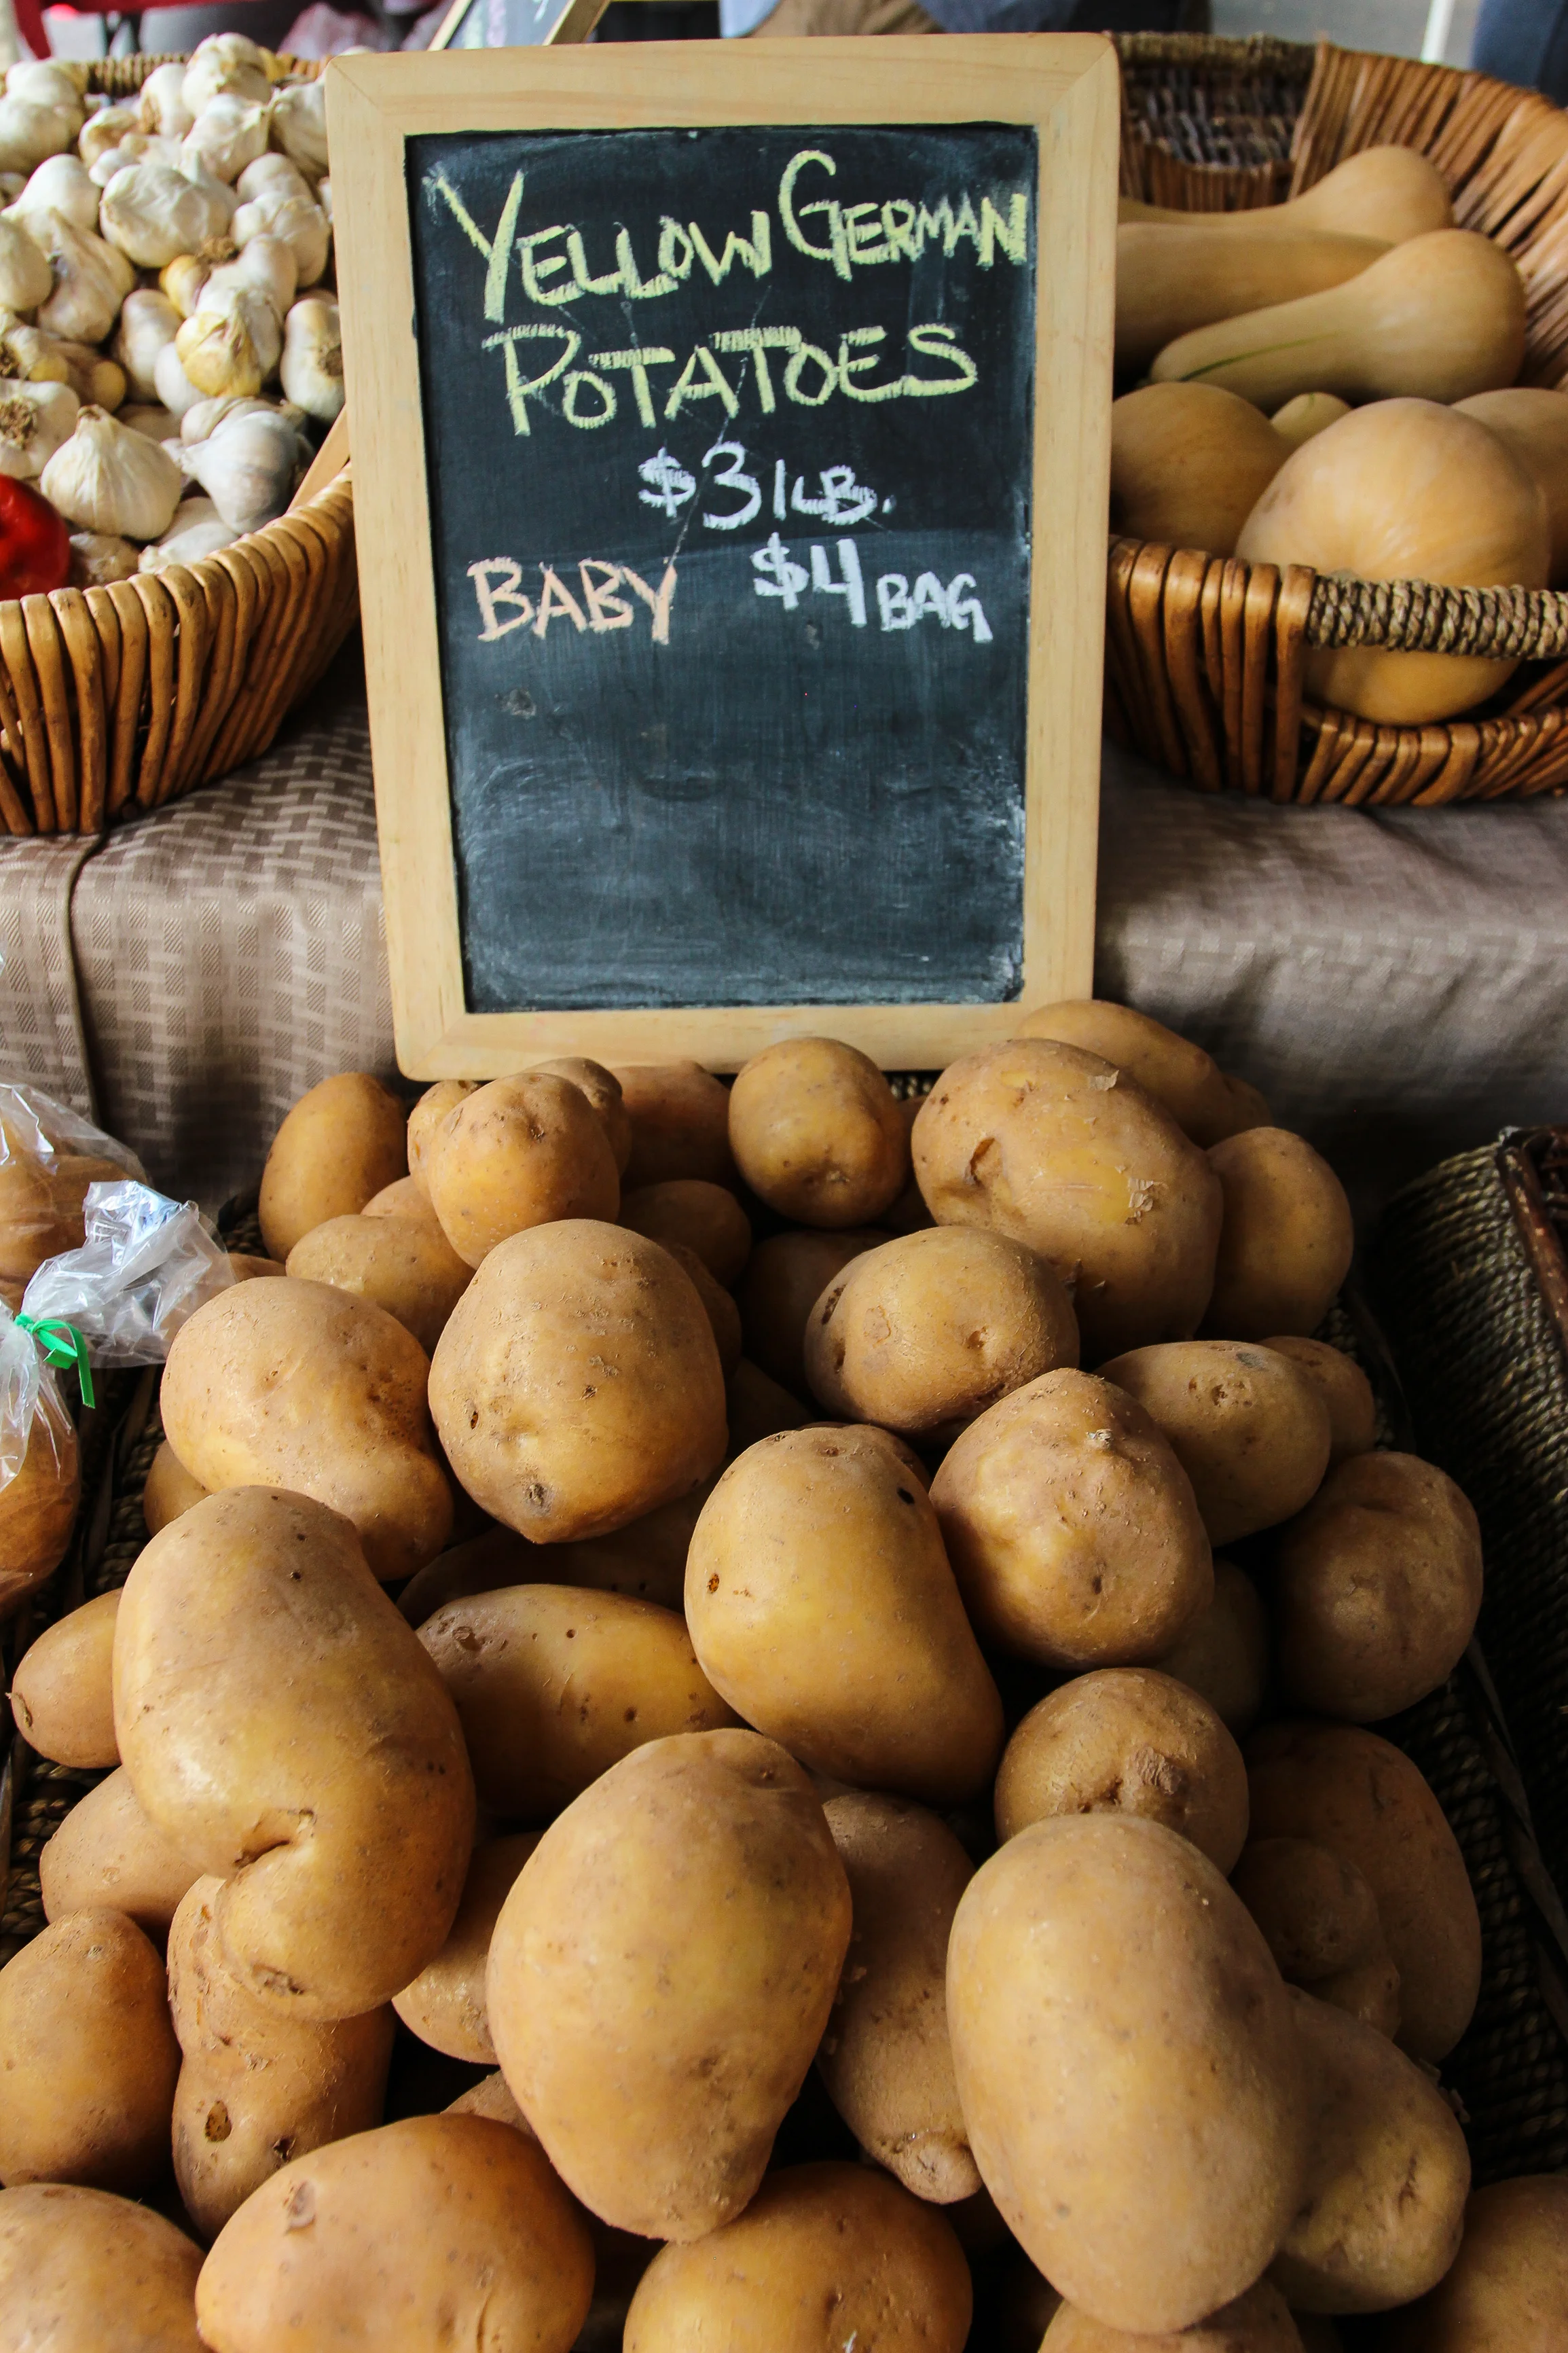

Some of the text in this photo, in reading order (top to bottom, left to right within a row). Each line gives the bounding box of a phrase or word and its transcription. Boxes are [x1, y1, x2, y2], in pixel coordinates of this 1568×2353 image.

[422, 150, 1027, 322] YELLOW GERMAN
[482, 324, 978, 436] POTATOES
[467, 532, 993, 645] BABY $4 BAG
